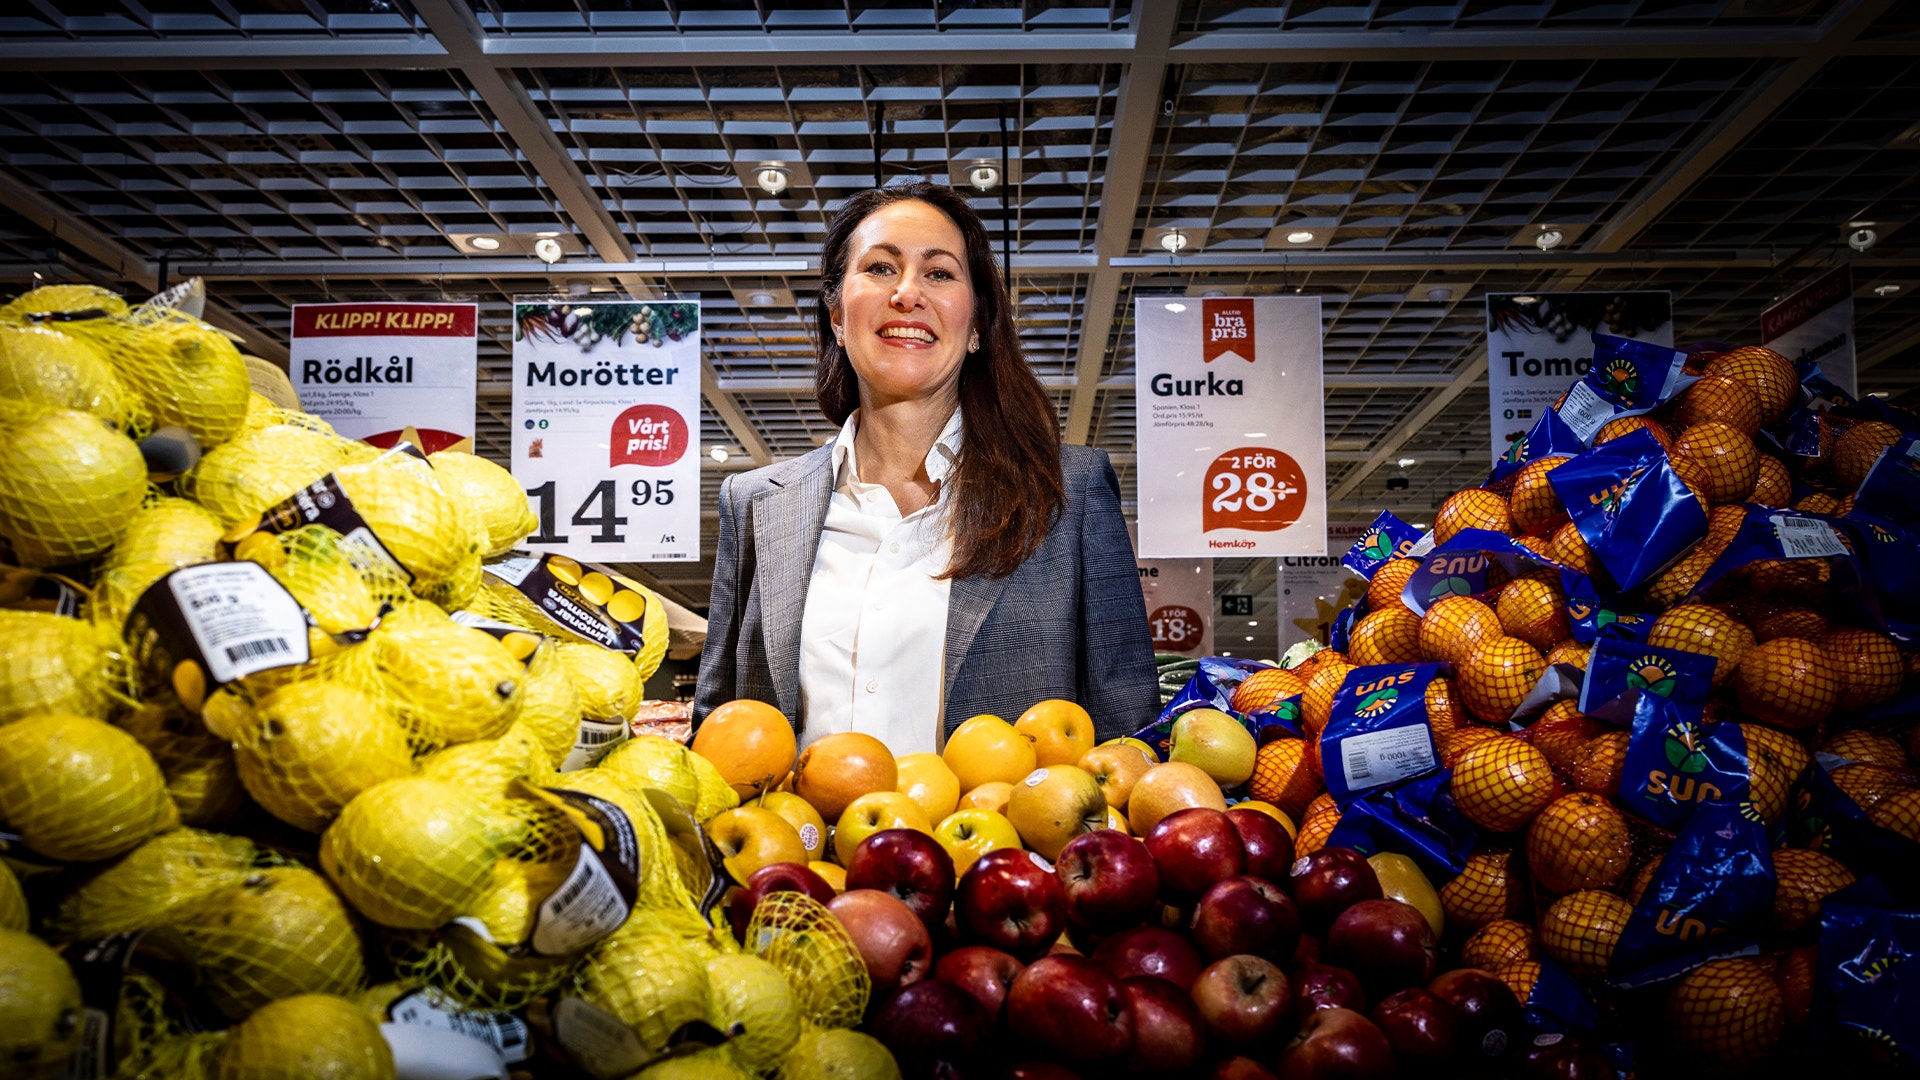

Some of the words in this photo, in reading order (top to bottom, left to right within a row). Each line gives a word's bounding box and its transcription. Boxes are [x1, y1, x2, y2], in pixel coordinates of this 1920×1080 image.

[315, 312, 381, 329] KLIPP!
[385, 312, 455, 329] KLIPP!
[1214, 313, 1245, 327] bra
[1211, 327, 1247, 341] pris
[1797, 333, 1846, 361] lommon
[303, 356, 413, 384] Rödkål
[527, 361, 678, 386] Morötter
[1502, 352, 1592, 376] Toma
[1151, 371, 1243, 396] Gurka
[628, 417, 670, 435] Vårt
[627, 435, 669, 455] pris!
[1231, 456, 1240, 468] 2
[1244, 454, 1276, 468] FÖR
[1212, 472, 1298, 512] 28:-
[526, 480, 628, 543] 14
[632, 480, 674, 505] 95
[660, 534, 675, 543] /st
[1209, 539, 1256, 549] Hemköp
[1138, 567, 1159, 577] me
[1169, 608, 1187, 617] FÖR
[555, 609, 613, 646] Limonar
[1355, 672, 1416, 697] sun
[1388, 751, 1406, 760] 1000
[1647, 769, 1722, 803] sun
[1655, 909, 1729, 942] un
